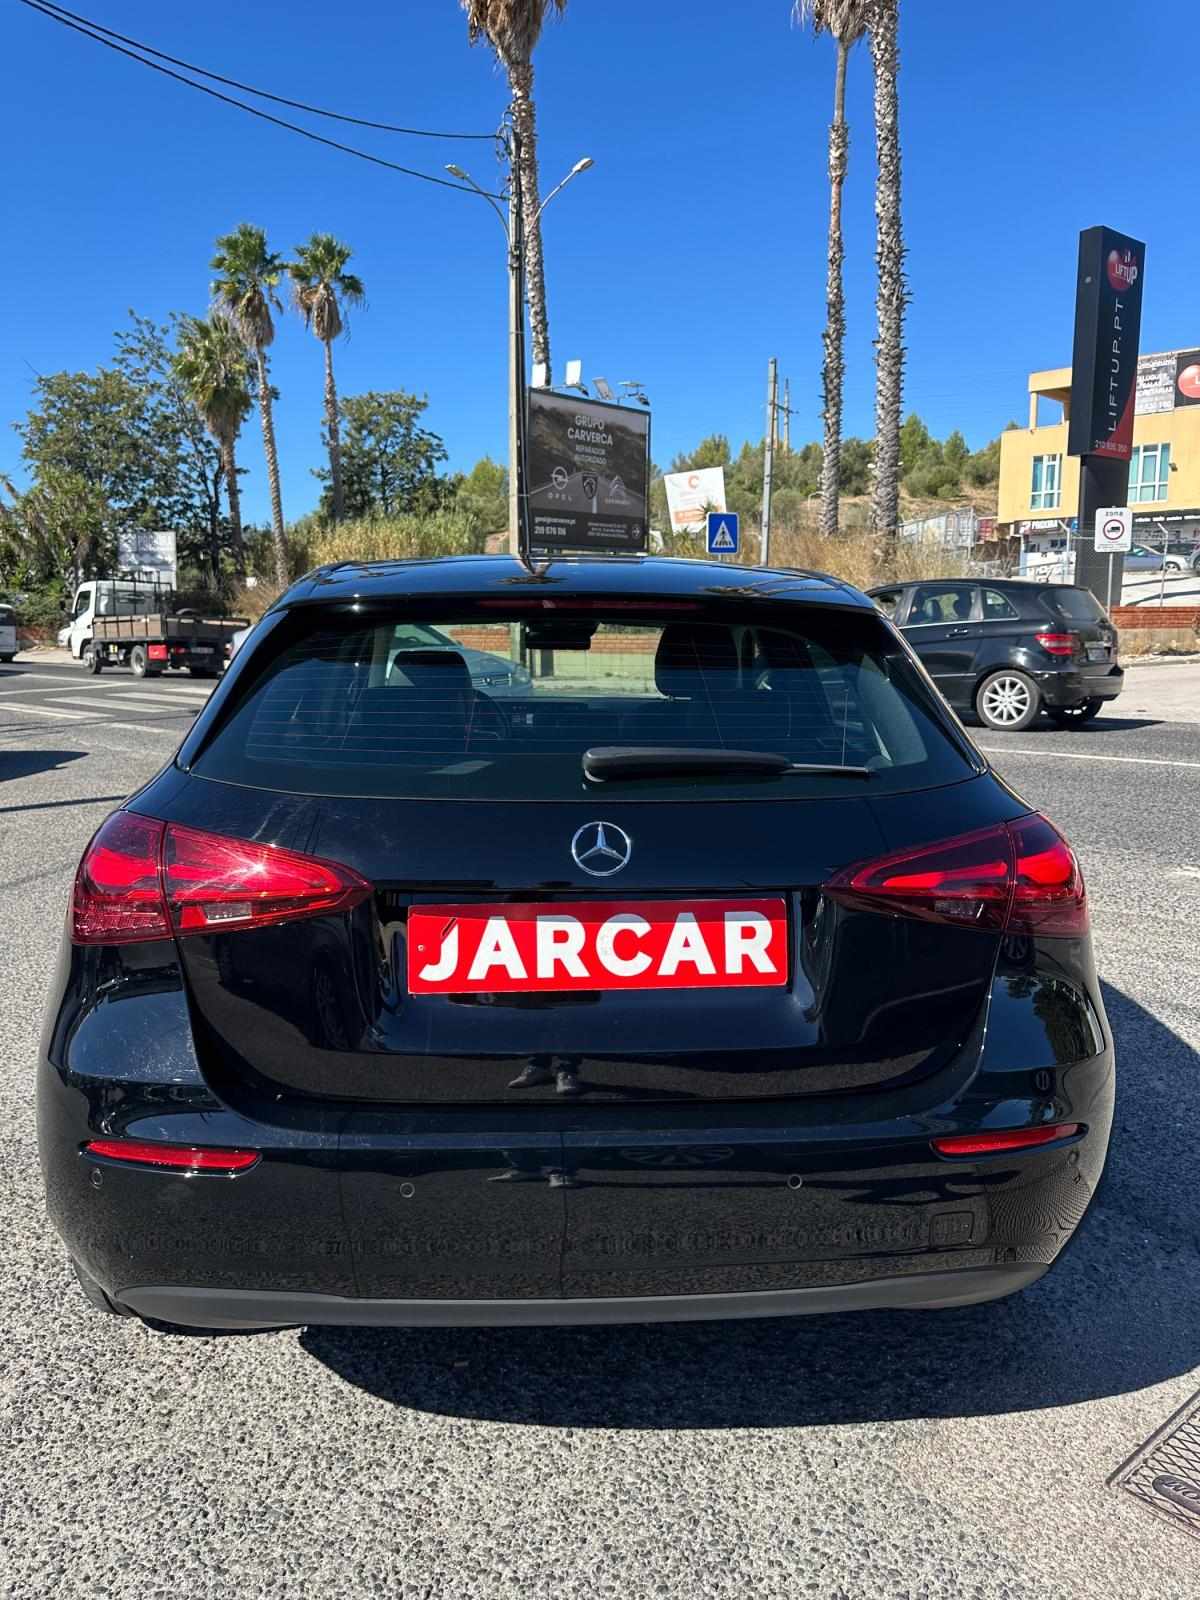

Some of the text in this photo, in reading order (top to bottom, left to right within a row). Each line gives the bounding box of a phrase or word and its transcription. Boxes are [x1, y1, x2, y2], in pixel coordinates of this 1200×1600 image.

[1108, 298, 1124, 432] LIFTUP.PT
[567, 427, 613, 446] CARVERCA
[575, 415, 605, 430] GRUPO
[418, 911, 778, 982] JARCAR
